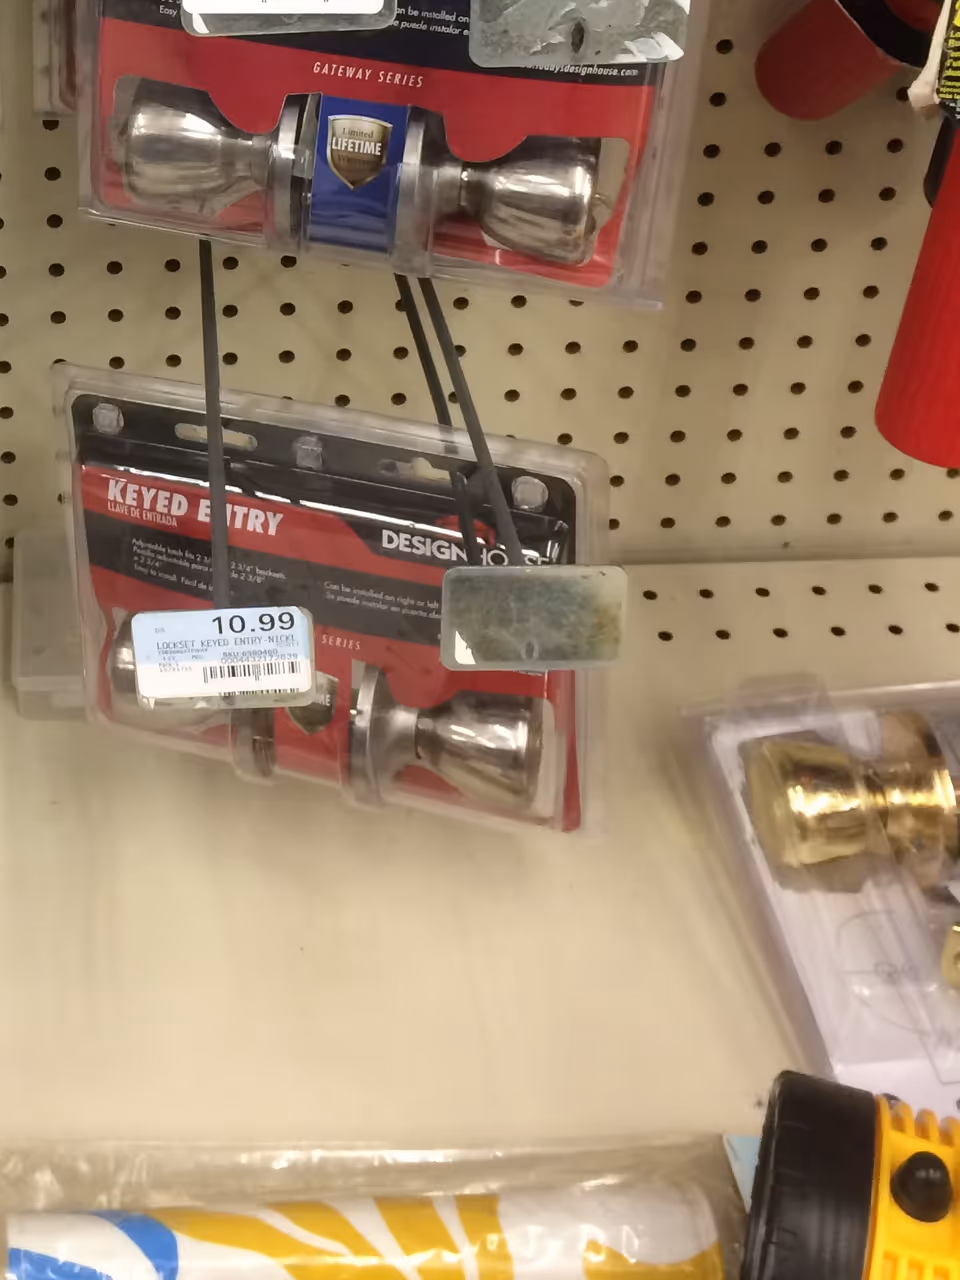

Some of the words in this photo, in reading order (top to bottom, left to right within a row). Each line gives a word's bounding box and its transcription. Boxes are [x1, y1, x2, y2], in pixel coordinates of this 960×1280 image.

[420, 9, 456, 22] installed
[313, 61, 372, 81] GATEWAY
[378, 68, 424, 89] SERIES
[341, 126, 375, 140] Limited
[331, 135, 383, 157] LIFETIME
[107, 477, 189, 516] KEYED
[107, 501, 130, 518] LLAVE
[131, 507, 141, 519] DE
[142, 509, 178, 528] ENTRADA
[212, 611, 296, 635] 10.99
[156, 640, 196, 650] LOCKSET
[200, 638, 229, 648] KEYED
[321, 633, 362, 651] SERIES
